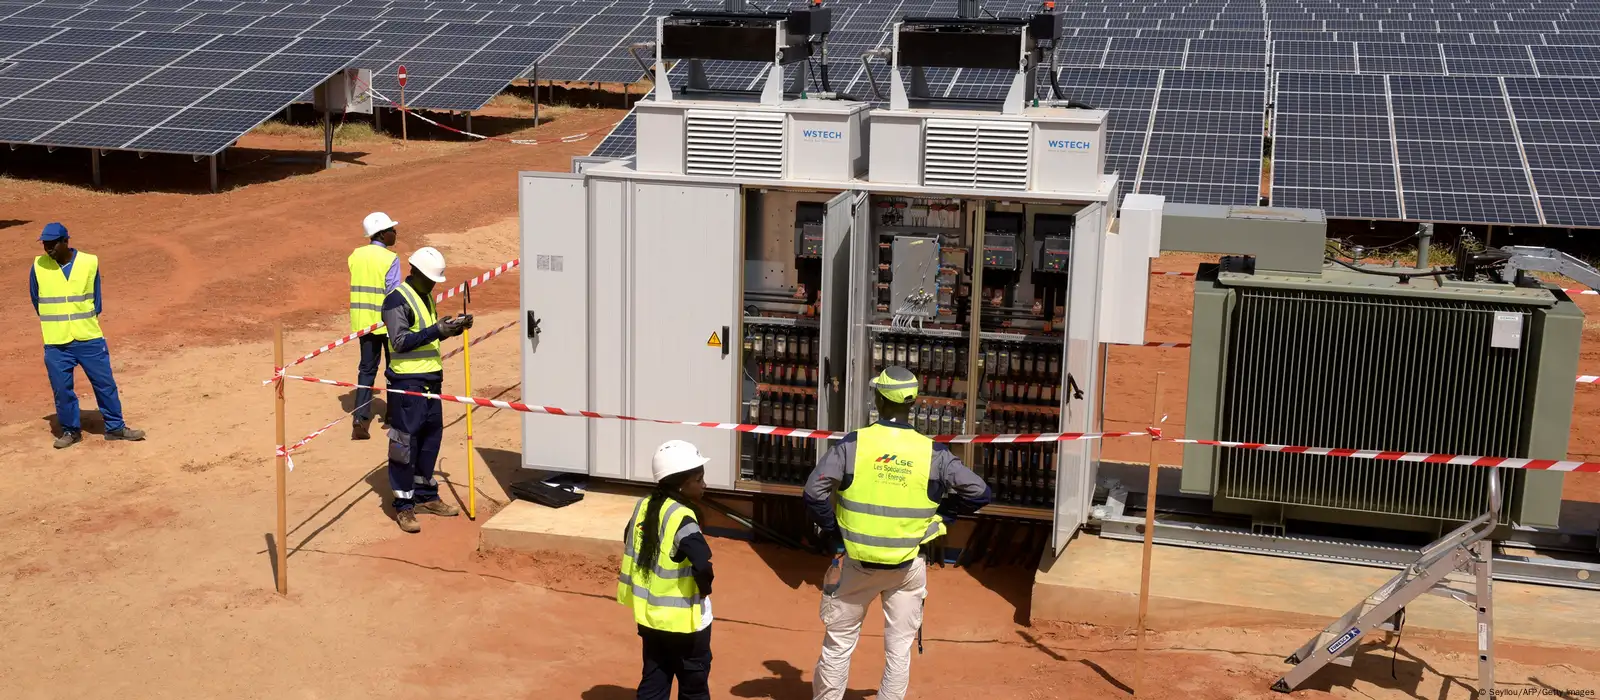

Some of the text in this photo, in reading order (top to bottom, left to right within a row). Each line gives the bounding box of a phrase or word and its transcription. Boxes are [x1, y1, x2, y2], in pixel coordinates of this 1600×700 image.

[803, 130, 842, 139] WSTECH
[1048, 140, 1090, 149] WSTECH
[873, 463, 883, 471] Les
[895, 459, 914, 468] LSE
[1330, 635, 1350, 651] TUBESCA
